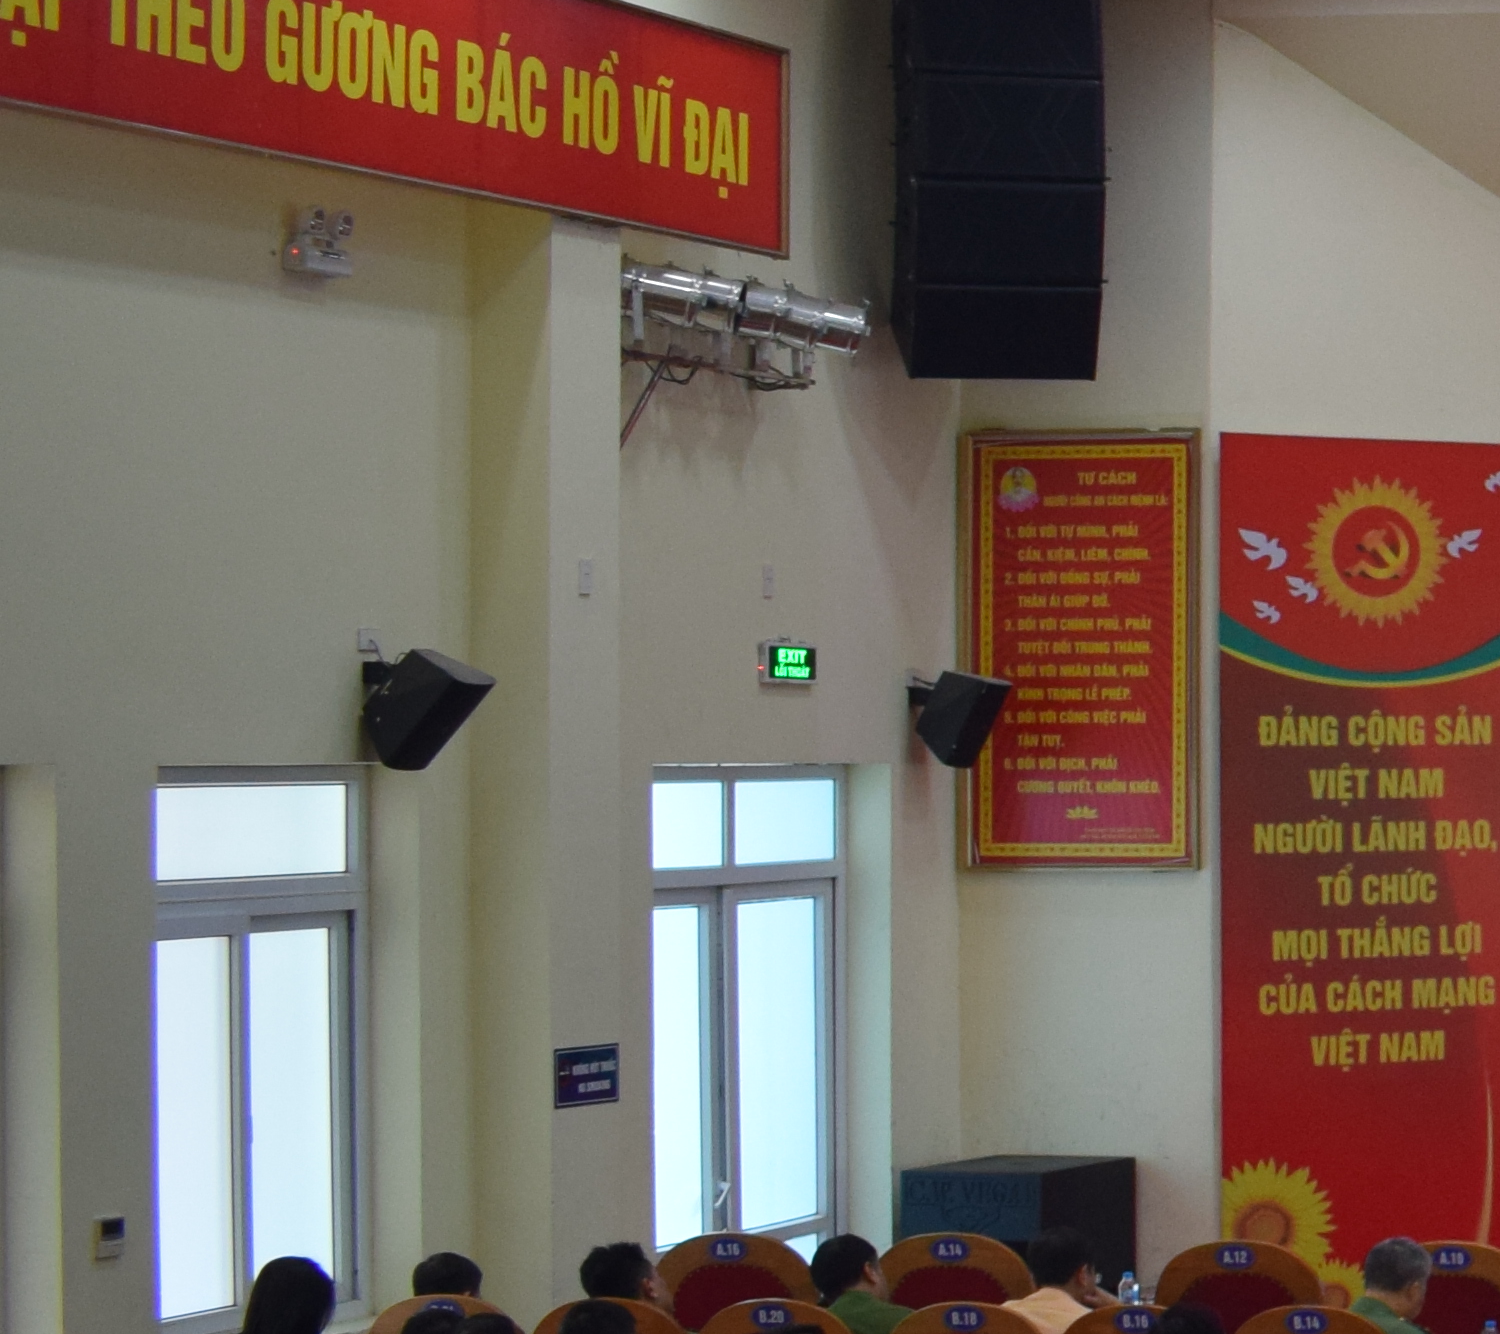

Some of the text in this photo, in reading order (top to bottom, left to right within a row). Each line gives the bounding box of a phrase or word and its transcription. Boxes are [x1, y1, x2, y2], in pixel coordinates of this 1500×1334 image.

[456, 32, 546, 138] BÁC
[563, 50, 619, 154] HỒ
[634, 77, 671, 168] VĨ
[683, 99, 750, 198] ĐẠI
[778, 648, 807, 664] EXIT
[1258, 705, 1492, 752] ĐẢNG CỘNG SẢN
[1309, 763, 1443, 806] VIỆT NAM
[1254, 816, 1497, 856] NGƯỜI LÃNH ĐẠO,
[1362, 867, 1437, 905] CHỨC
[1272, 916, 1482, 967] MỌI THẮNG LỢI
[1259, 973, 1494, 1015] CỦA CÁCH MẠNG
[1311, 1028, 1444, 1072] VIỆT NAM
